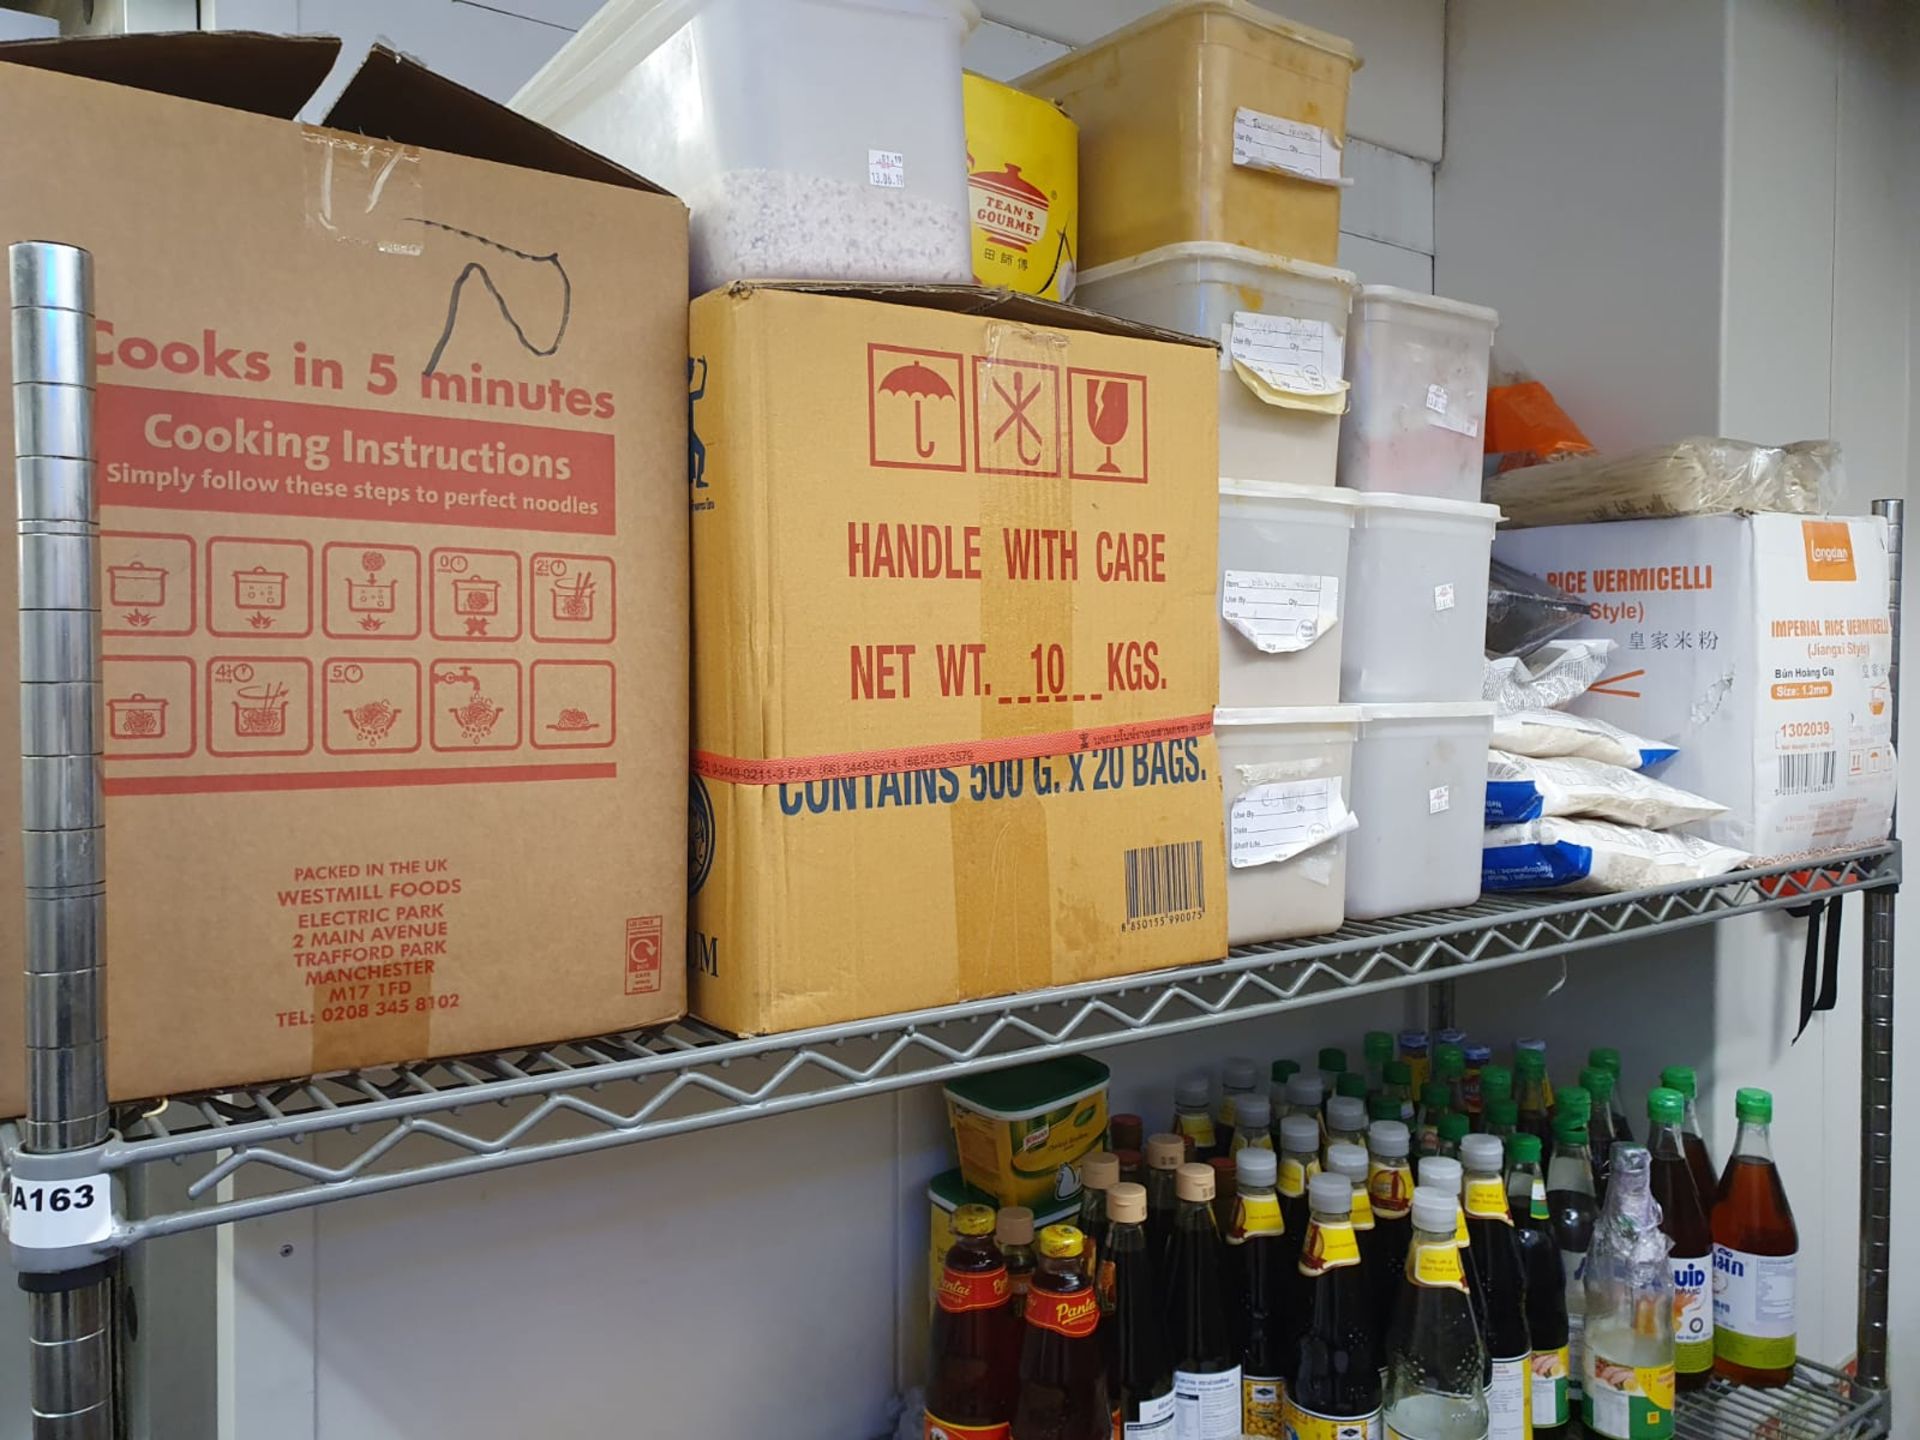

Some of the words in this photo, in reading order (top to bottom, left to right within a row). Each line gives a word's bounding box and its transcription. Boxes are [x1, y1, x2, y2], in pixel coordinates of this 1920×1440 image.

[977, 208, 1041, 237] GOURMET
[986, 197, 1035, 220] TEAN'S
[293, 341, 343, 390] in
[367, 353, 398, 396] 5
[421, 362, 616, 420] minutes
[144, 413, 331, 472] Cooking
[343, 429, 572, 481] Instructions
[107, 462, 195, 493] Simply
[201, 468, 279, 493] follow
[285, 475, 348, 498] these
[354, 482, 411, 507] steps
[416, 486, 439, 504] to
[444, 489, 517, 510] perfect
[523, 496, 600, 517] noodles
[848, 522, 982, 580] HANDLE
[1003, 528, 1078, 581] WITH
[1096, 531, 1166, 583] CARE
[1547, 571, 1587, 593] RICE
[1593, 565, 1713, 593] VERMICELLI
[1590, 601, 1644, 624] Style)
[1628, 630, 1719, 650] 皇家米粉
[1771, 619, 1822, 637] IMPERIAL
[1824, 618, 1845, 636] RICE
[851, 645, 916, 700] NET
[936, 644, 991, 697] WT.
[1031, 643, 1065, 694] 10
[1107, 641, 1167, 691] KGS.
[1781, 721, 1830, 737] 1302039
[779, 767, 959, 817] CONTAINS
[970, 755, 1024, 801] 500
[1033, 756, 1060, 795] G.
[1093, 746, 1123, 790] 20
[1132, 736, 1207, 787] BAGS.
[294, 864, 360, 883] PACKED
[366, 863, 384, 877] IN
[389, 860, 420, 876] THE
[425, 859, 448, 873] UK
[278, 884, 383, 907] WESTMILL
[390, 879, 462, 899] FOODS
[298, 908, 390, 929] ELECTRIC
[396, 903, 445, 921] PARK
[292, 934, 304, 949] 2
[311, 929, 365, 948] MAIN
[370, 922, 448, 942] AVENUE
[294, 945, 395, 968] TRAFFORD
[401, 940, 447, 958] PARK
[305, 959, 435, 986] MANCHESTER
[329, 985, 370, 1003] M17
[379, 981, 412, 997] 1FD
[276, 1010, 316, 1028] TEL:
[322, 1003, 369, 1022] 0208
[375, 999, 409, 1017] 345
[415, 993, 460, 1012] 8102
[13, 1184, 94, 1212] A163
